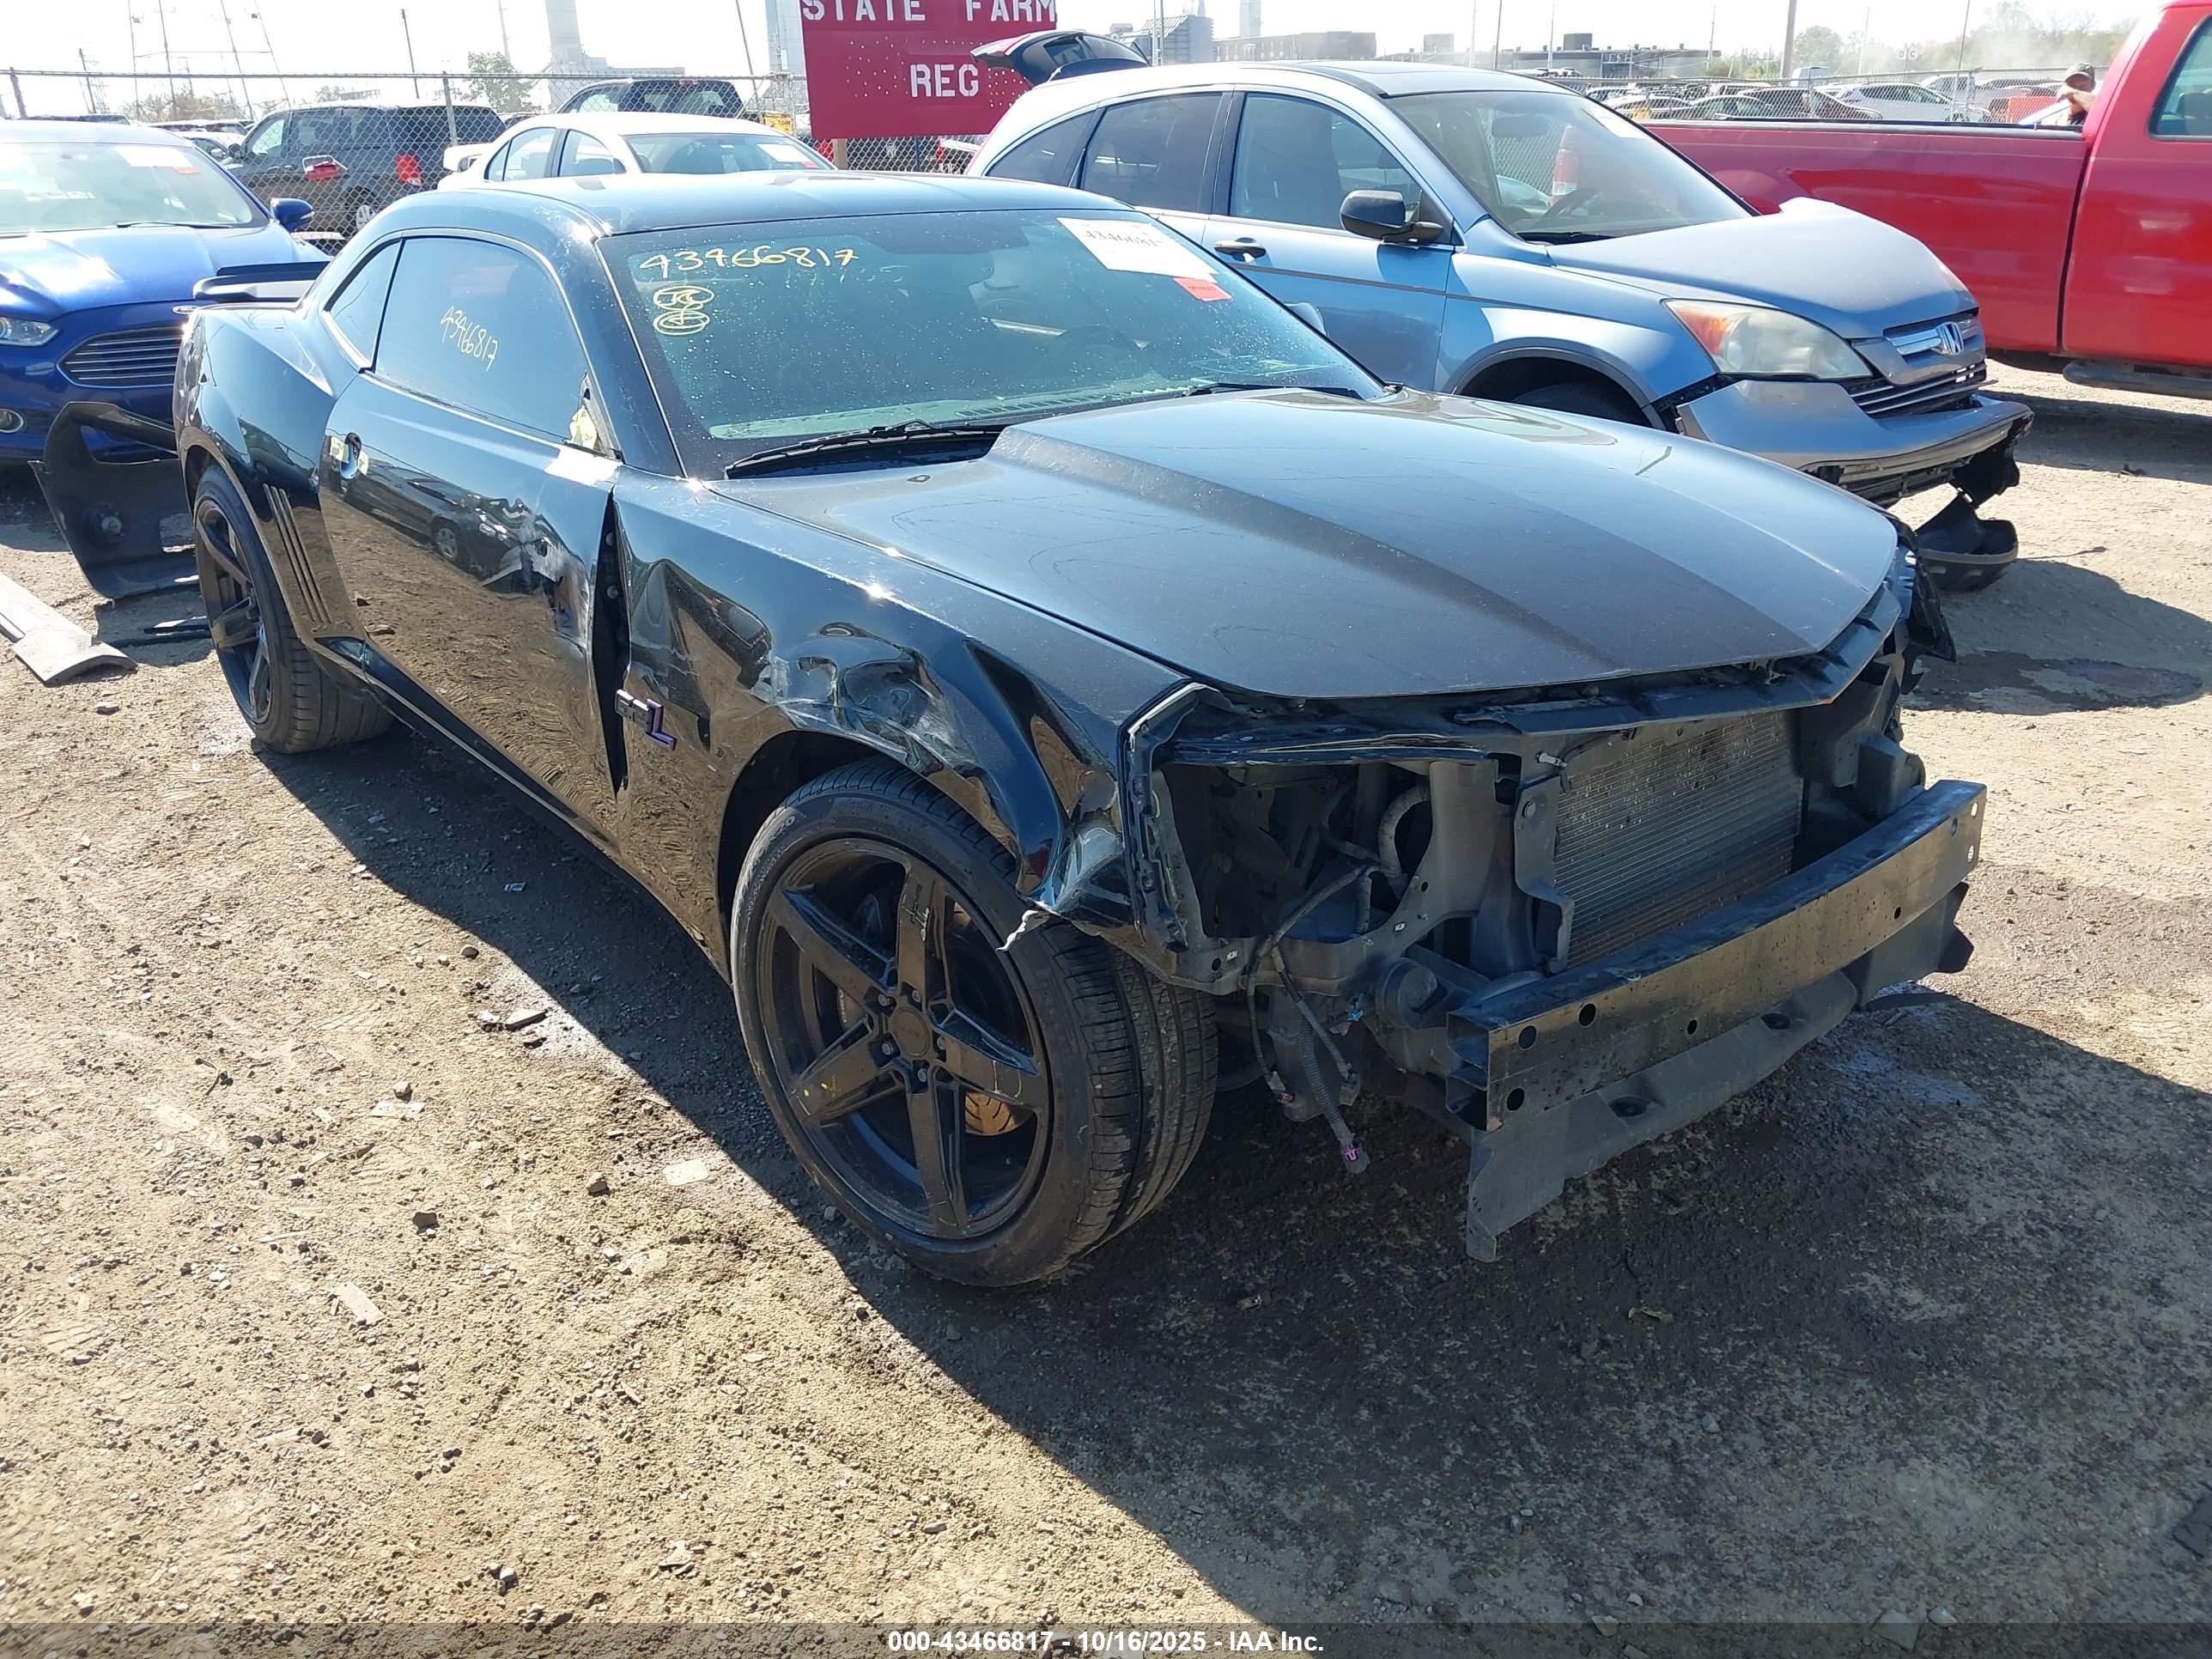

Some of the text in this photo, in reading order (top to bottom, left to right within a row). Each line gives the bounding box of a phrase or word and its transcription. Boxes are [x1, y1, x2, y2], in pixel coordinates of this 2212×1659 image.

[803, 0, 1056, 22] STATE FARM
[910, 64, 979, 98] REG
